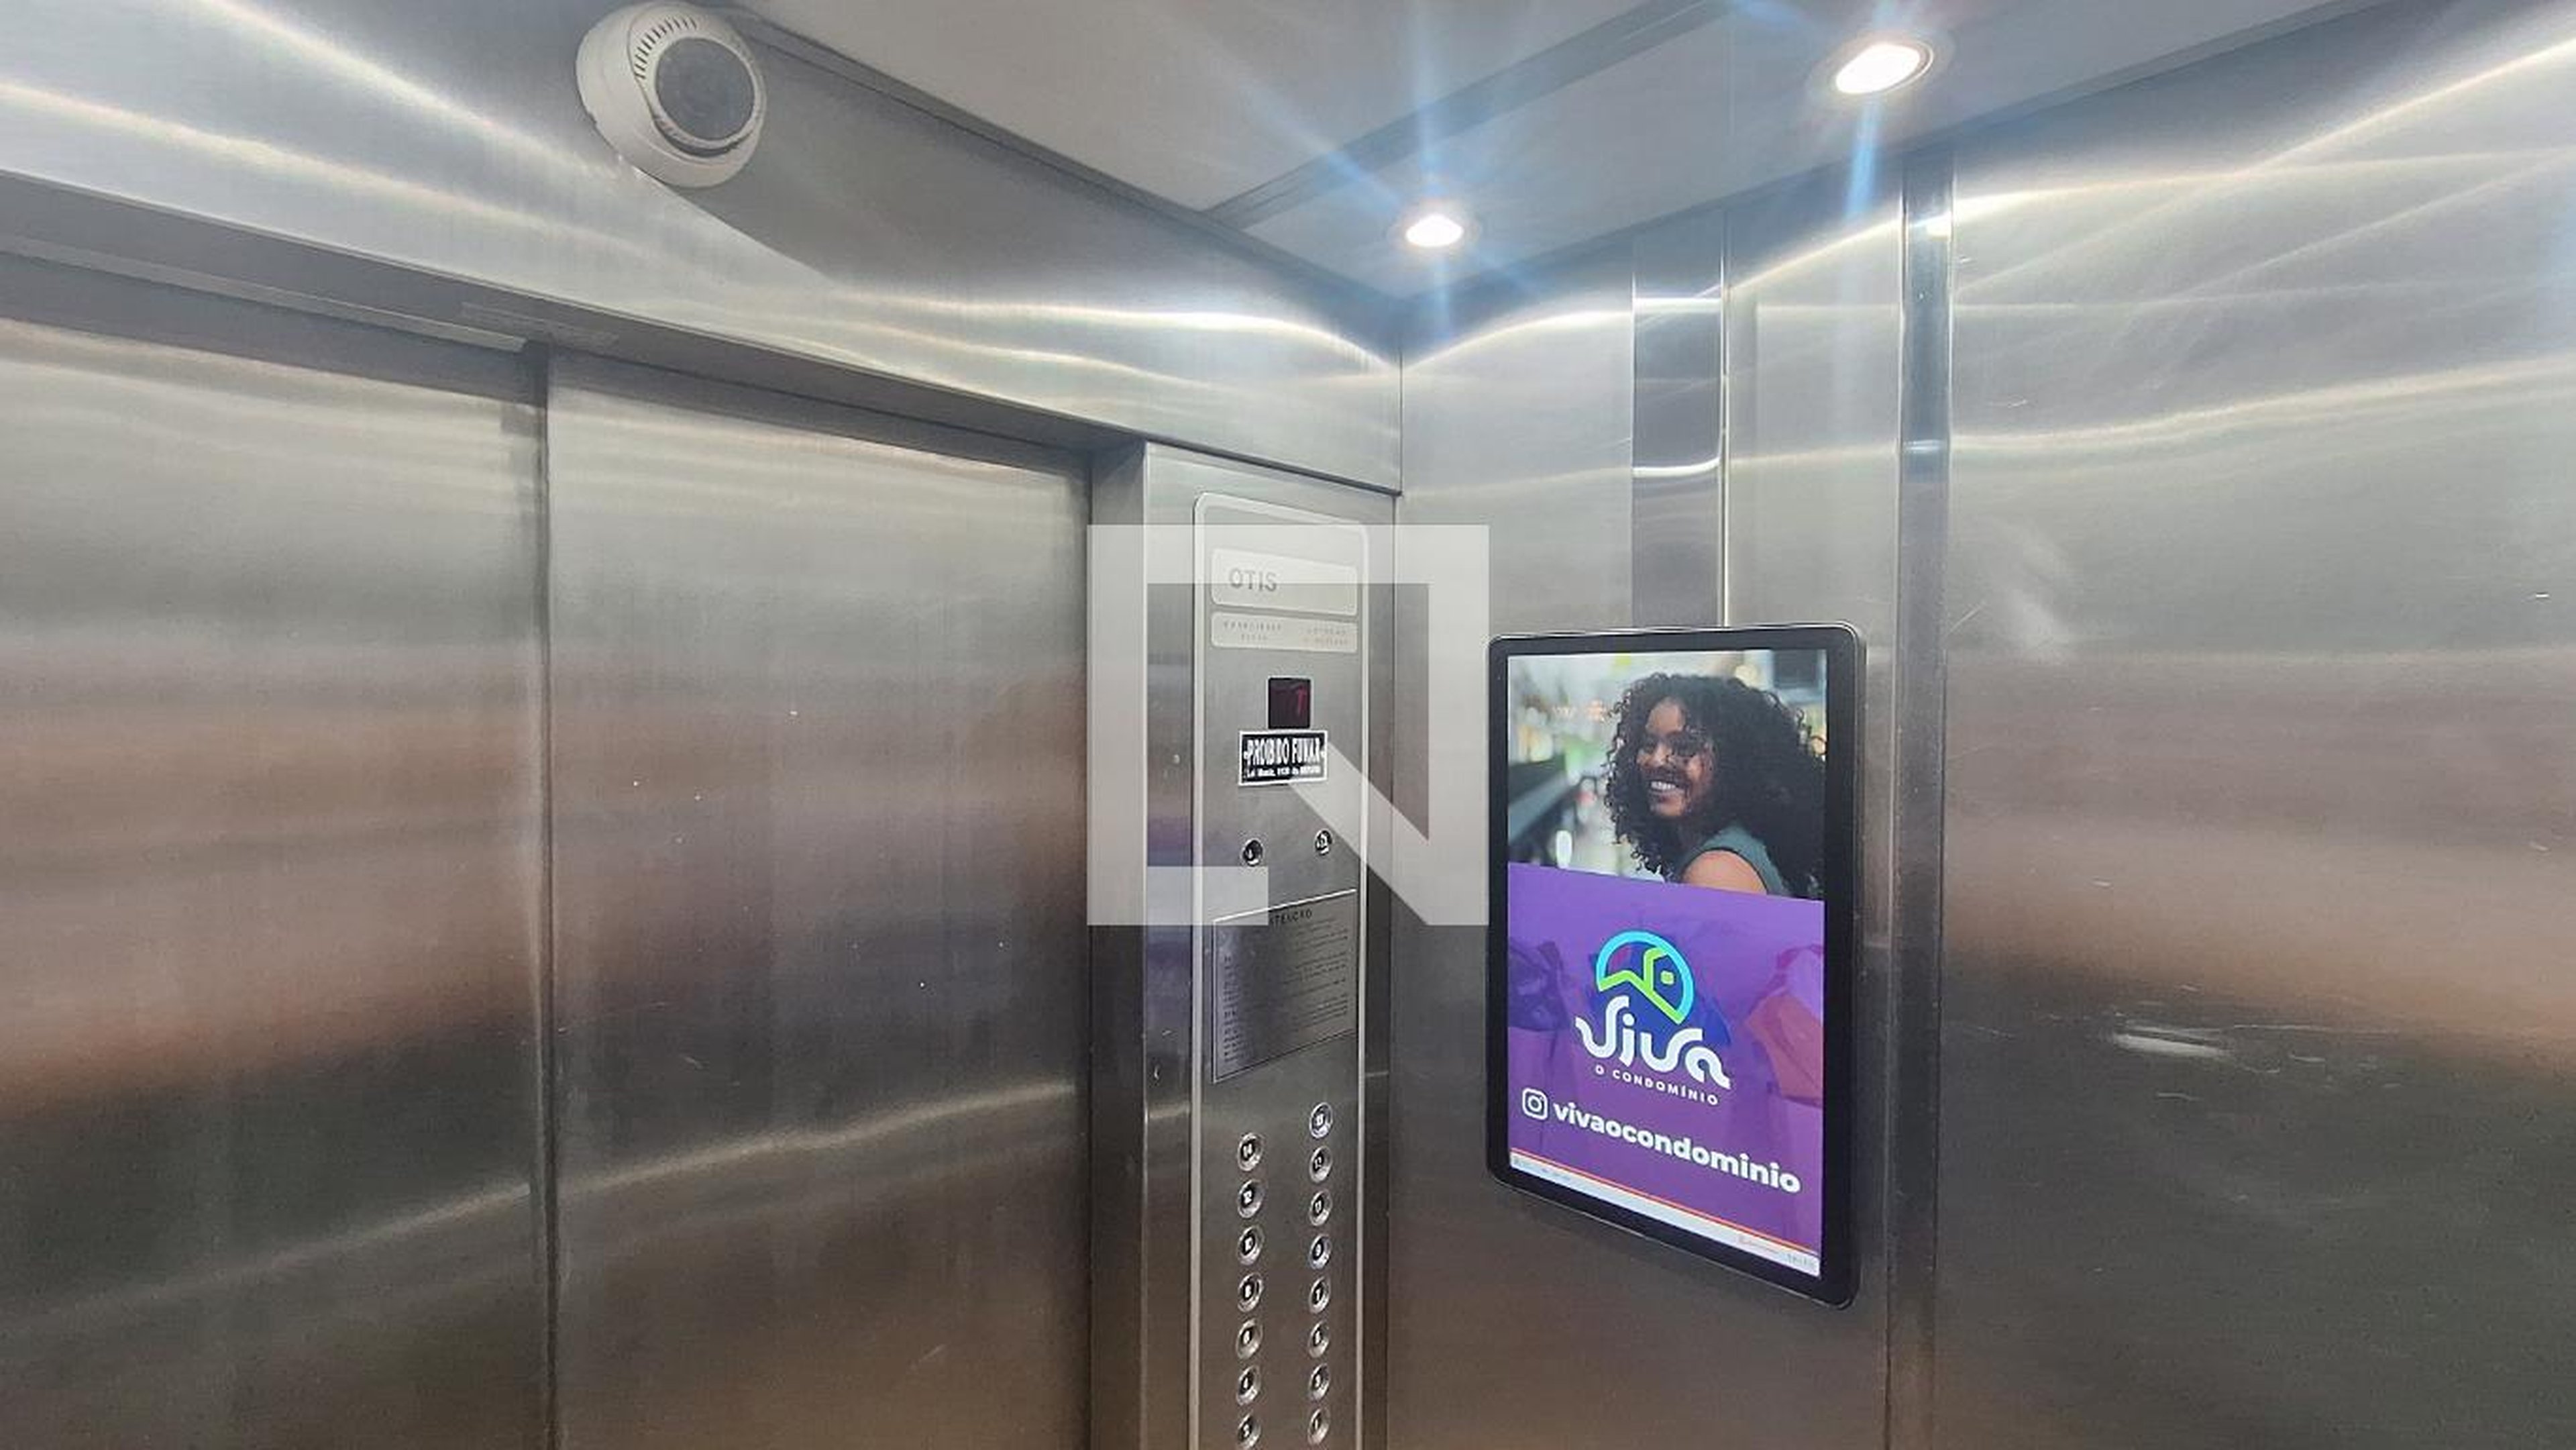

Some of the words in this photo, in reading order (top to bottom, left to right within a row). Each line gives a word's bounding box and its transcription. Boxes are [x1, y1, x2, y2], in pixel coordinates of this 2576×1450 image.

[1228, 568, 1277, 592] OTIS
[1595, 1064, 1605, 1075] O
[1612, 1069, 1719, 1106] CONDOMÍNIO
[1552, 1102, 1802, 1193] vivaocondominio
